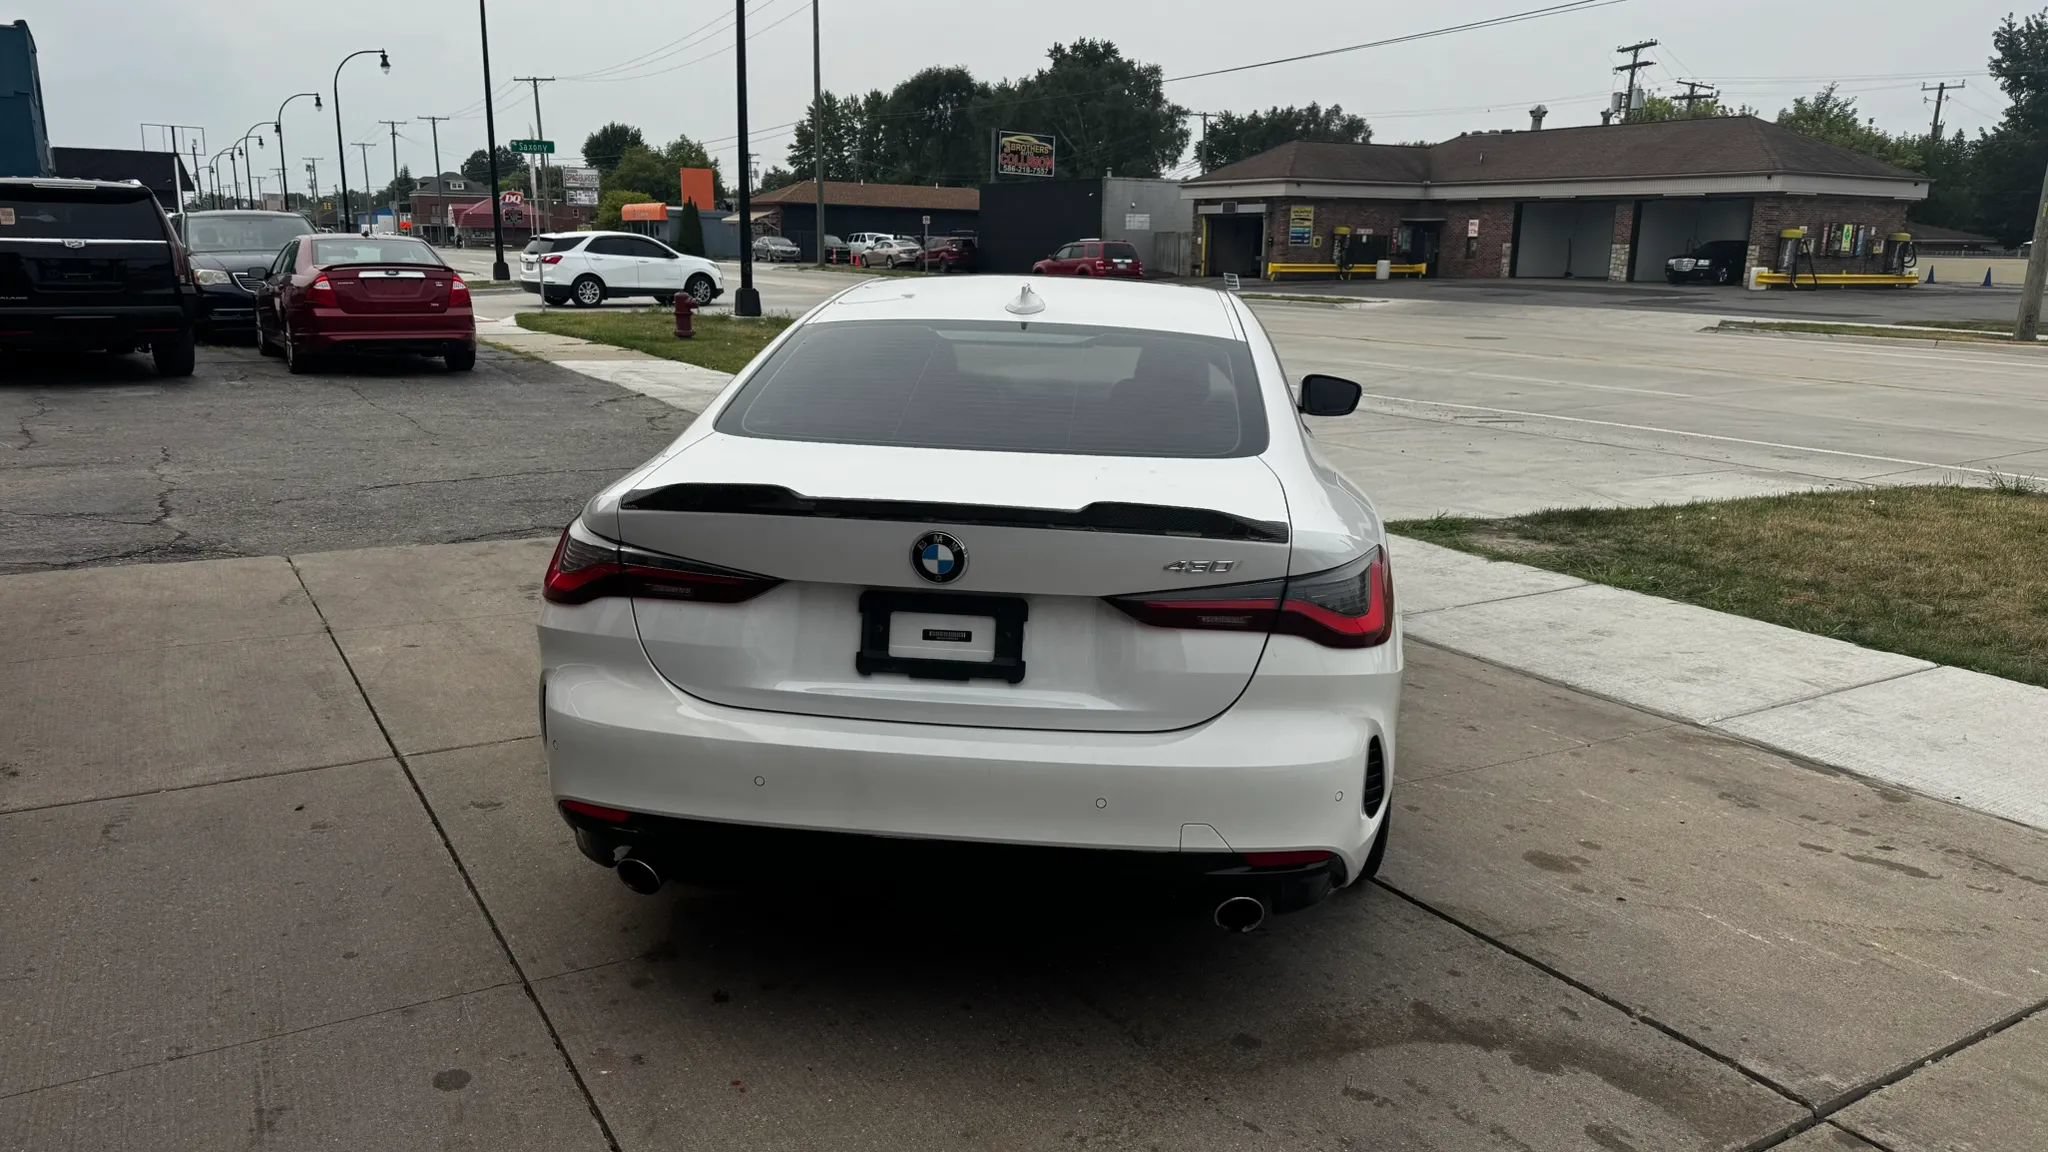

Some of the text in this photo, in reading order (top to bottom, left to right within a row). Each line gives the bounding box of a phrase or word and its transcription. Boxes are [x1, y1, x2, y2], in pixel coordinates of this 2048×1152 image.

[518, 142, 548, 152] Saxony
[1010, 143, 1049, 154] BROTHERS
[505, 194, 521, 205] DQ
